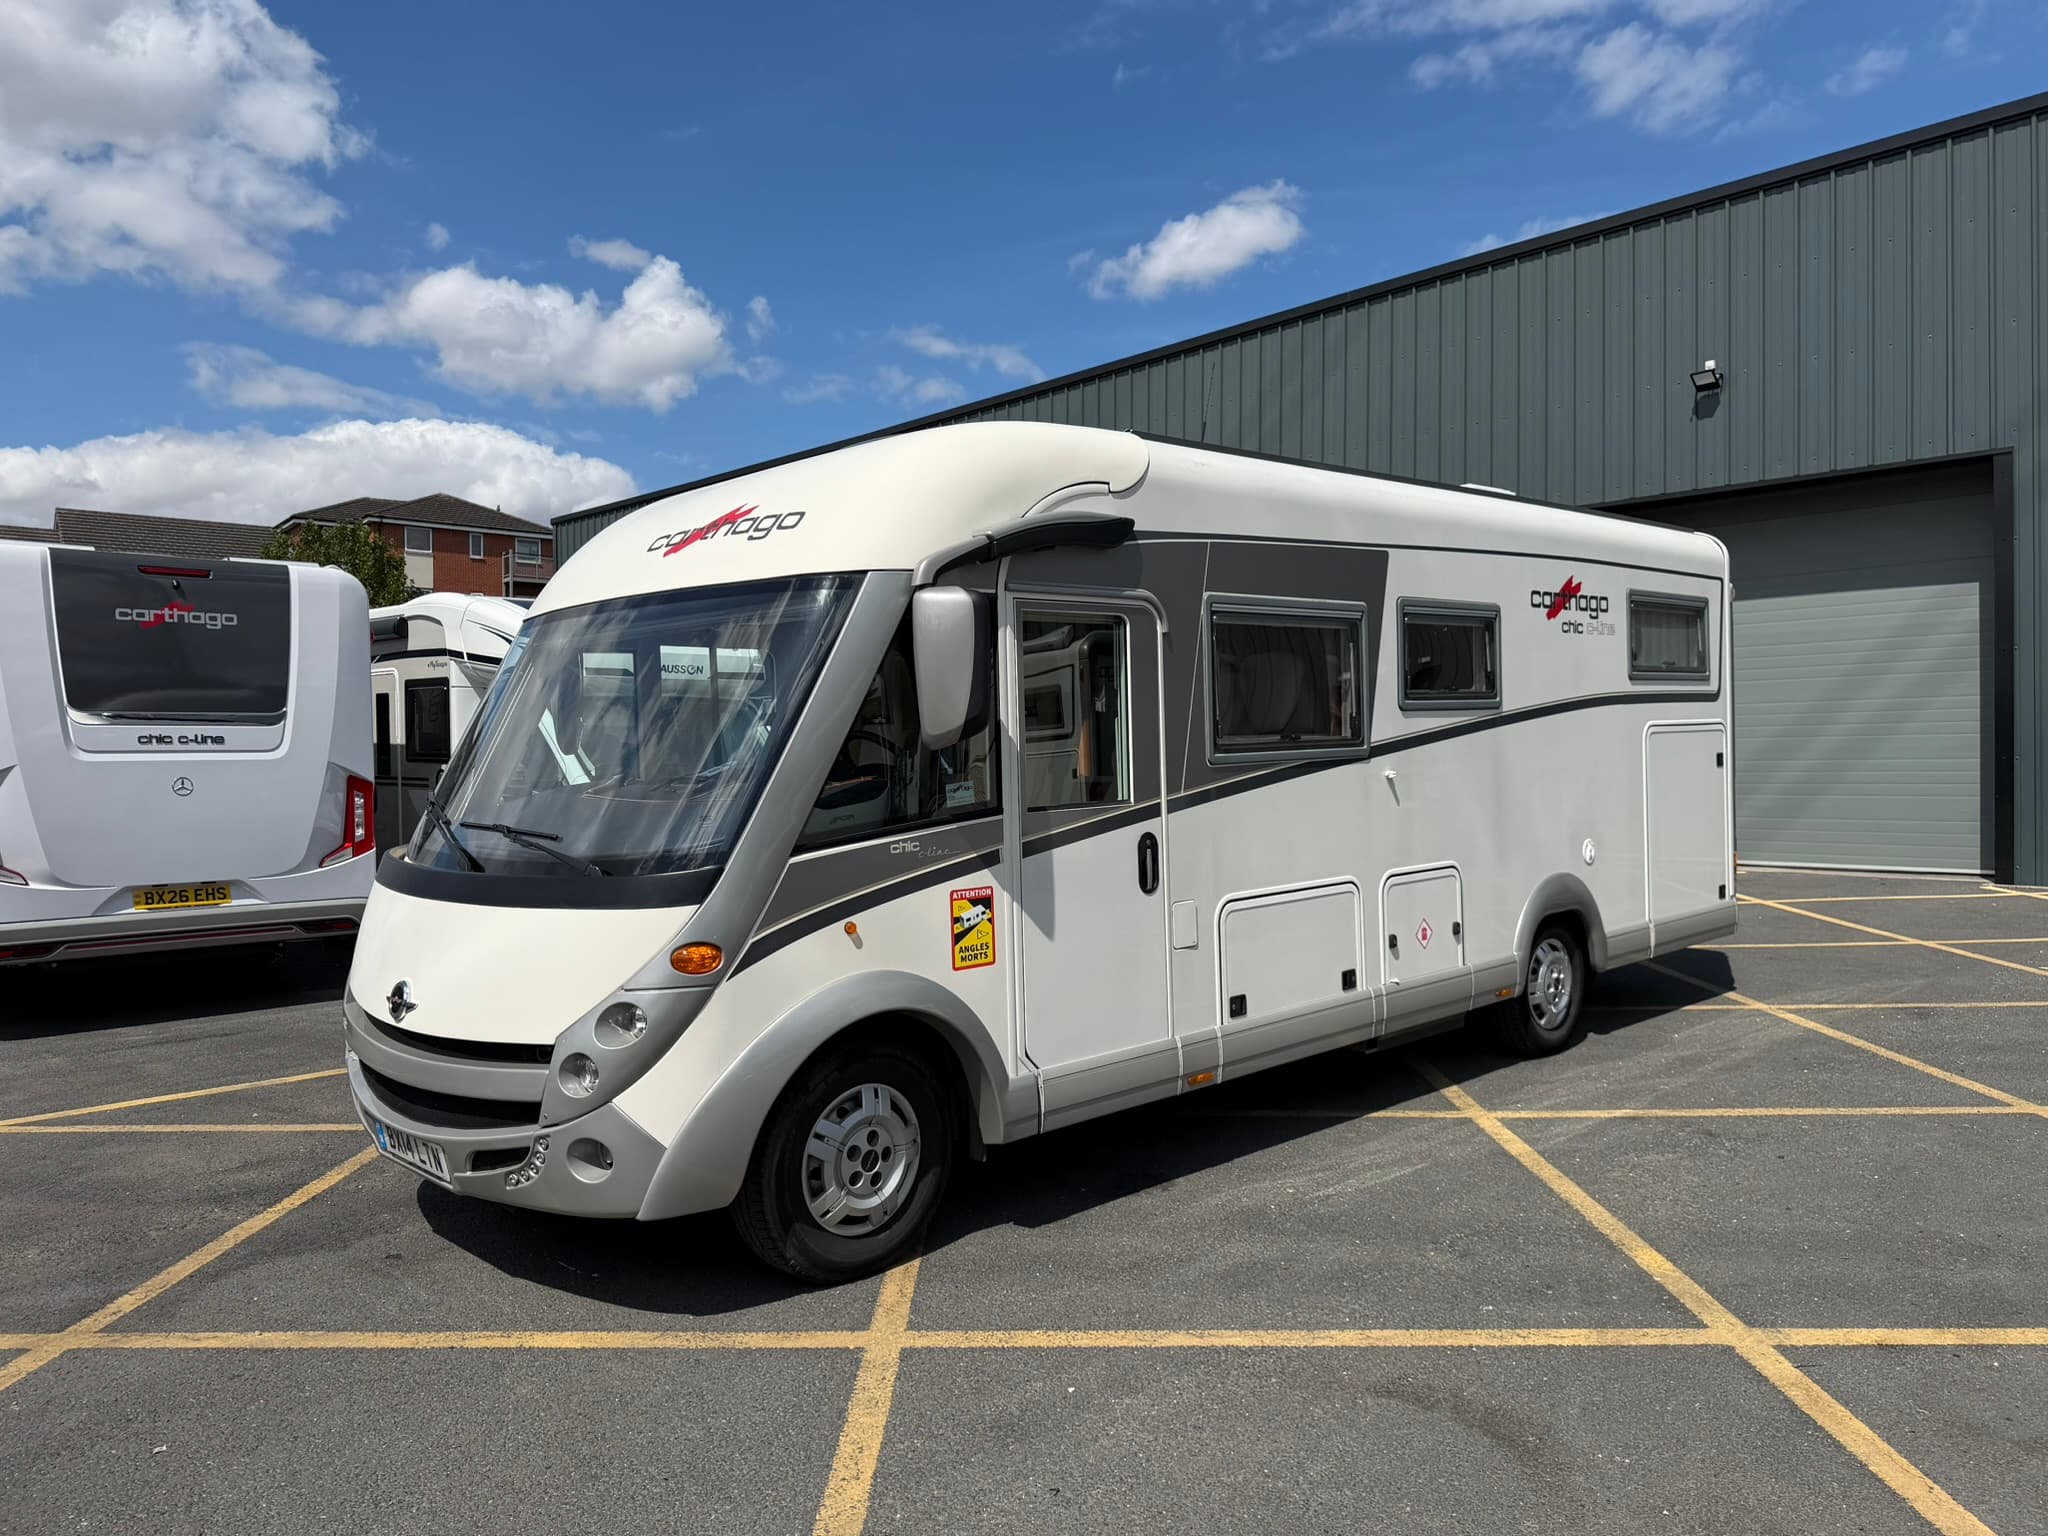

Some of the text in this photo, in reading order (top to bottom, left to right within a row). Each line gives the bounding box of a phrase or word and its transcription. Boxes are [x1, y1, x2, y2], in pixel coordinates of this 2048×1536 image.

[647, 511, 806, 552] carthago
[1530, 589, 1609, 620] carthago
[115, 607, 238, 629] carthago
[1561, 620, 1584, 634] chic
[137, 733, 225, 745] chic c-line
[889, 840, 920, 854] chic
[143, 886, 227, 906] BX26 EHS
[952, 887, 992, 899] ATTENTION
[958, 942, 990, 955] ANGLES
[960, 951, 989, 963] MORTS
[413, 1136, 444, 1175] LTN
